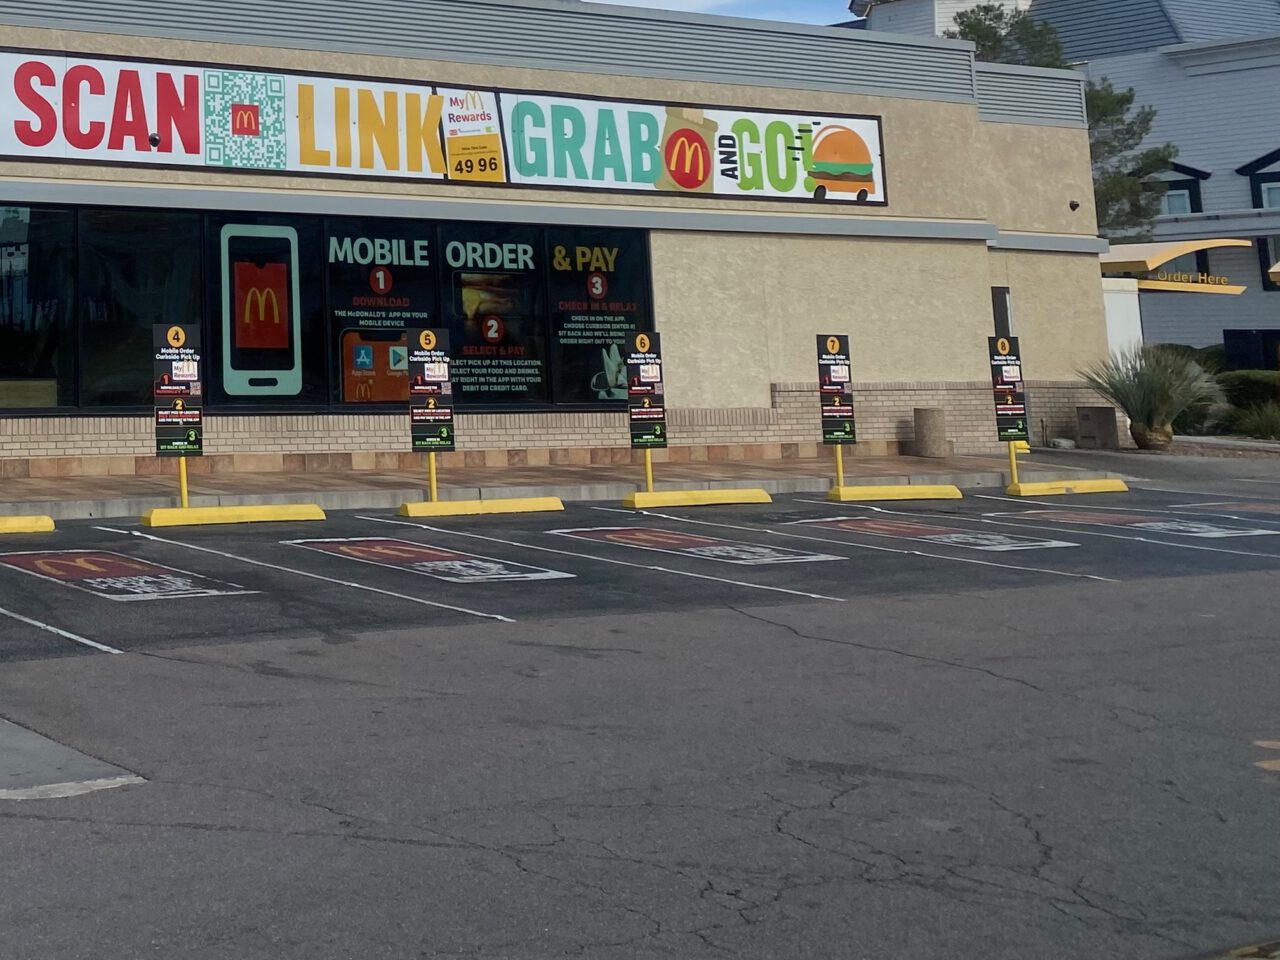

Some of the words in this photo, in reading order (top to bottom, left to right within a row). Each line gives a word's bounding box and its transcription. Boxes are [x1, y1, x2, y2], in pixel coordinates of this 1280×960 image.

[449, 97, 465, 109] My
[14, 61, 201, 155] SCAN
[298, 84, 447, 174] LINK
[448, 111, 492, 123] Rewards
[511, 101, 663, 183] GRAB
[718, 134, 739, 181] AND
[731, 118, 816, 193] GO!
[454, 159, 474, 173] 49
[478, 157, 498, 172] 96
[328, 236, 429, 266] MOBILE
[445, 241, 535, 269] ORDER
[553, 245, 572, 271] &
[575, 246, 618, 272] PAY
[376, 271, 385, 289] 1
[1157, 270, 1193, 283] Order
[1198, 272, 1228, 285] Here
[591, 276, 602, 294] 3
[352, 297, 410, 307] DOWNLOAD
[487, 319, 499, 337] 2
[172, 330, 180, 342] 4
[424, 334, 432, 346] 5
[640, 336, 646, 348] 6
[463, 346, 497, 355] SELECT
[508, 346, 525, 355] PAY
[830, 340, 836, 350] 7
[164, 374, 168, 384] 1
[176, 400, 182, 410] 2
[188, 430, 196, 440] 3
